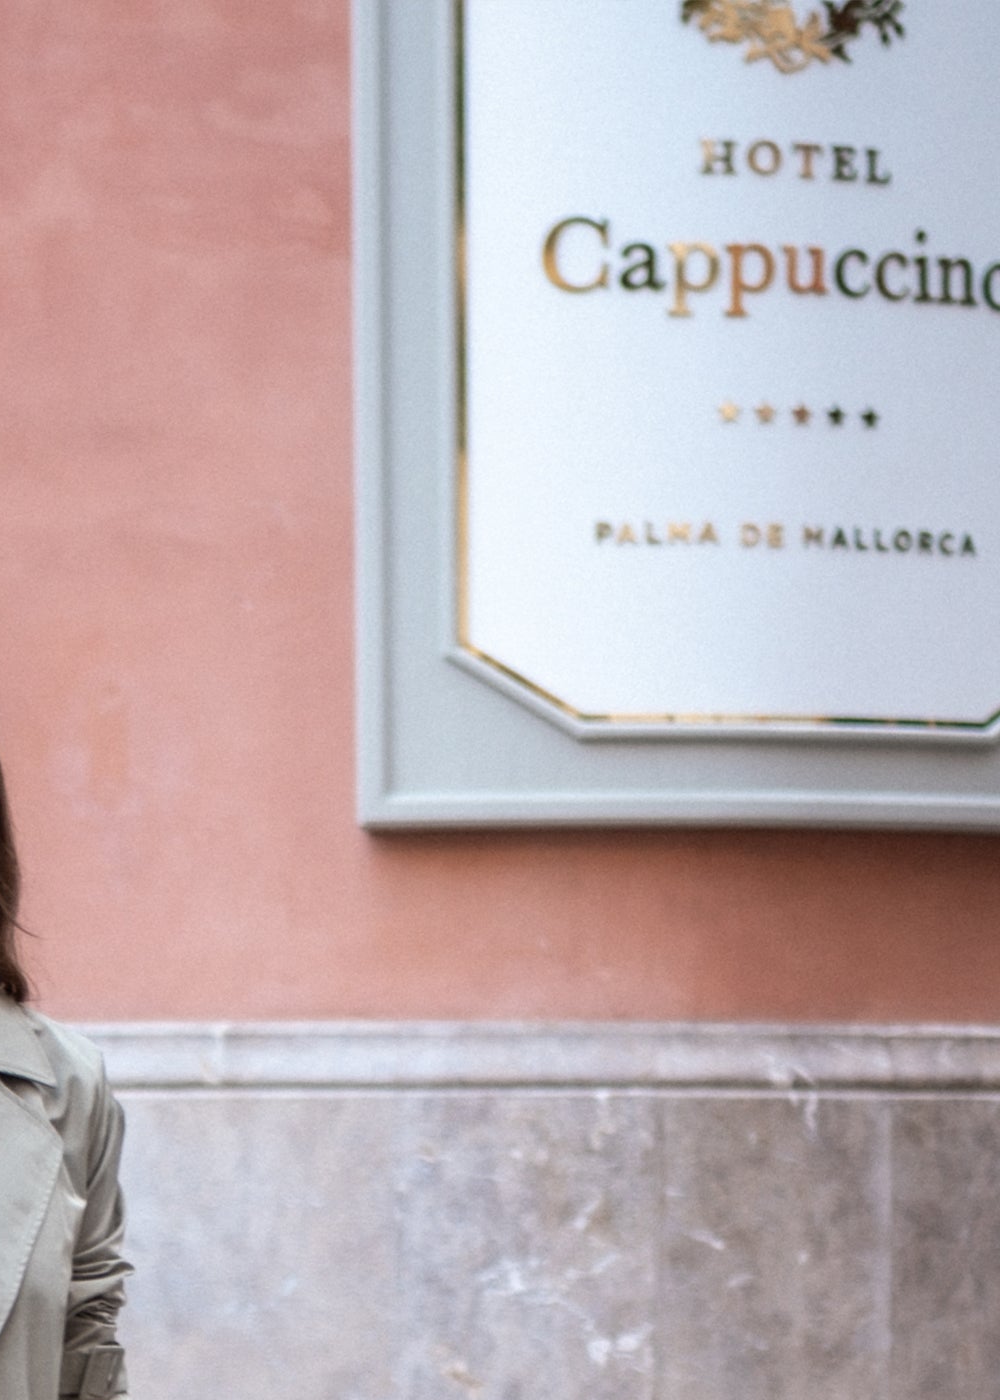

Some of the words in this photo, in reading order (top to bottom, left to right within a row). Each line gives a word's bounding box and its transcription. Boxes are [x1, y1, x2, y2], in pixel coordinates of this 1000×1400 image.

[700, 139, 891, 185] HOTEL
[594, 520, 720, 547] PALMA
[740, 522, 785, 551] DE
[803, 526, 977, 556] MALLORCA
